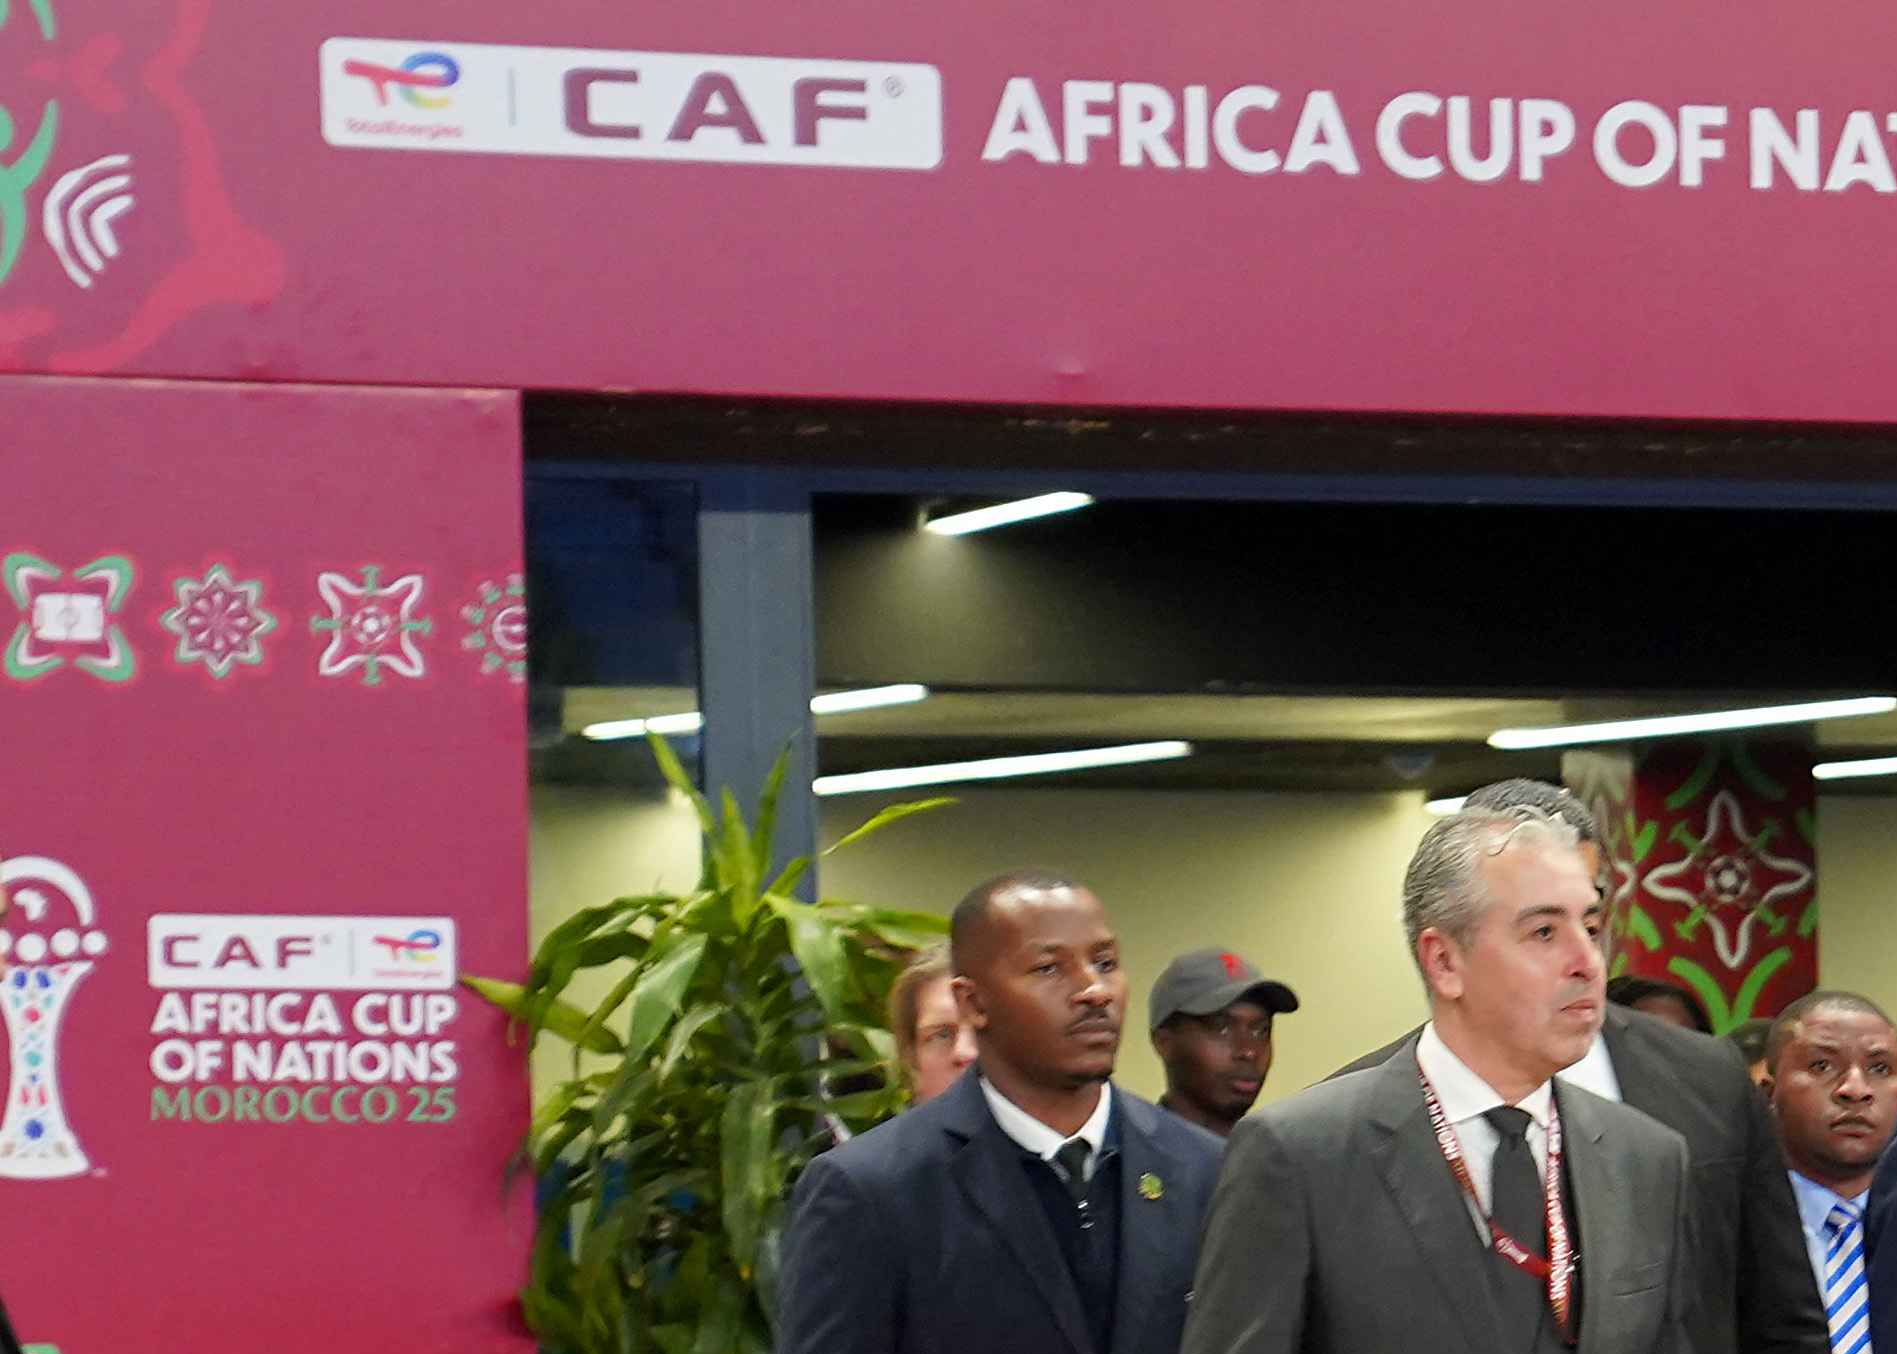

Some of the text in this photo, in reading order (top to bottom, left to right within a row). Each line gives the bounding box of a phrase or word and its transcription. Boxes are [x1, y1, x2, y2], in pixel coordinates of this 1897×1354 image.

[981, 77, 1361, 175] AFRICA
[1375, 91, 1576, 182] CUP
[1593, 100, 1728, 188] OF
[151, 992, 458, 1036] AFRICA CUP
[150, 1039, 457, 1083] OF NATIONS
[151, 1086, 457, 1123] MOROCCO 25
